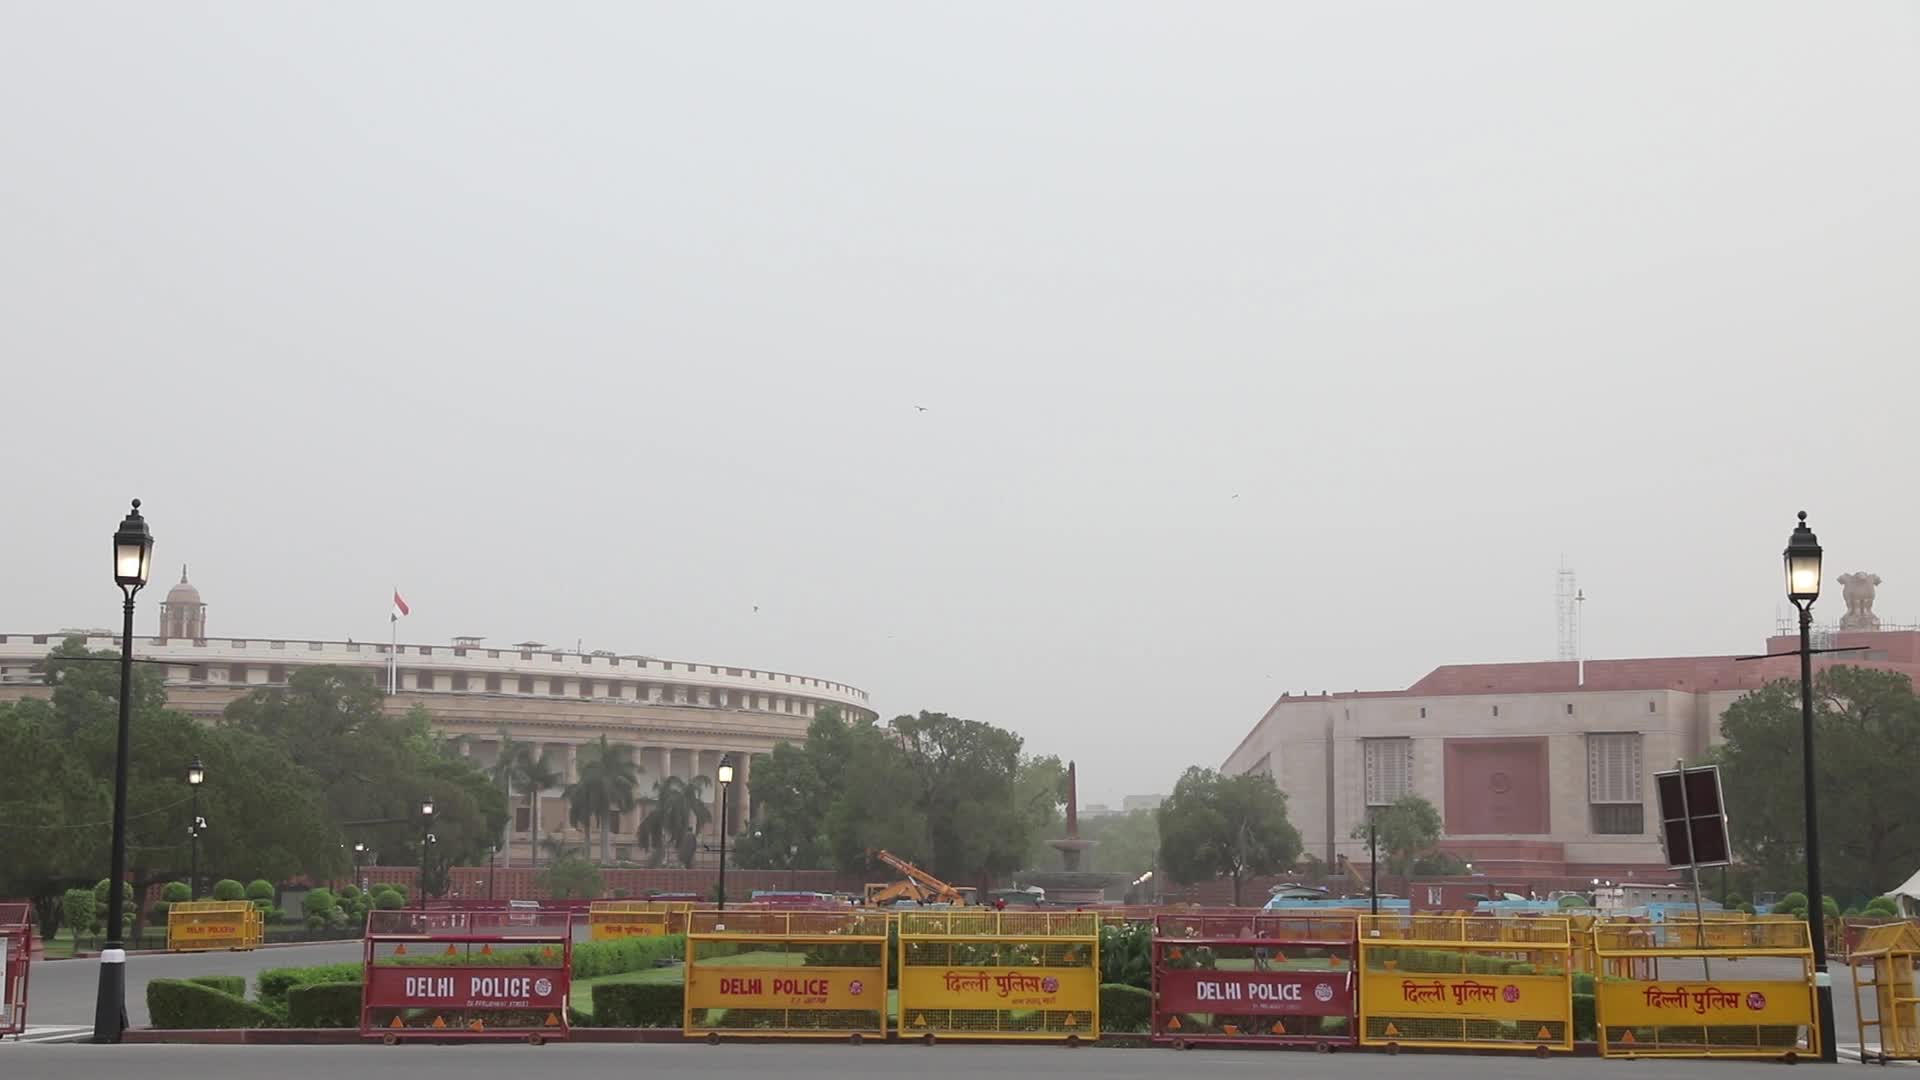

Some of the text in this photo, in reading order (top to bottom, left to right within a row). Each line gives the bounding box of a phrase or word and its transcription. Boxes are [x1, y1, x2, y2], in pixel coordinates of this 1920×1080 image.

[406, 977, 530, 997] DELHI POLICE
[720, 978, 829, 995] DELHI POLICE
[943, 971, 1041, 997] दिल्ली पुलिस
[1197, 981, 1302, 1000] DELHI POLICE
[1402, 980, 1498, 1005] दिल्ली पुलिस
[1643, 986, 1741, 1014] दिल्ली पुलिस
